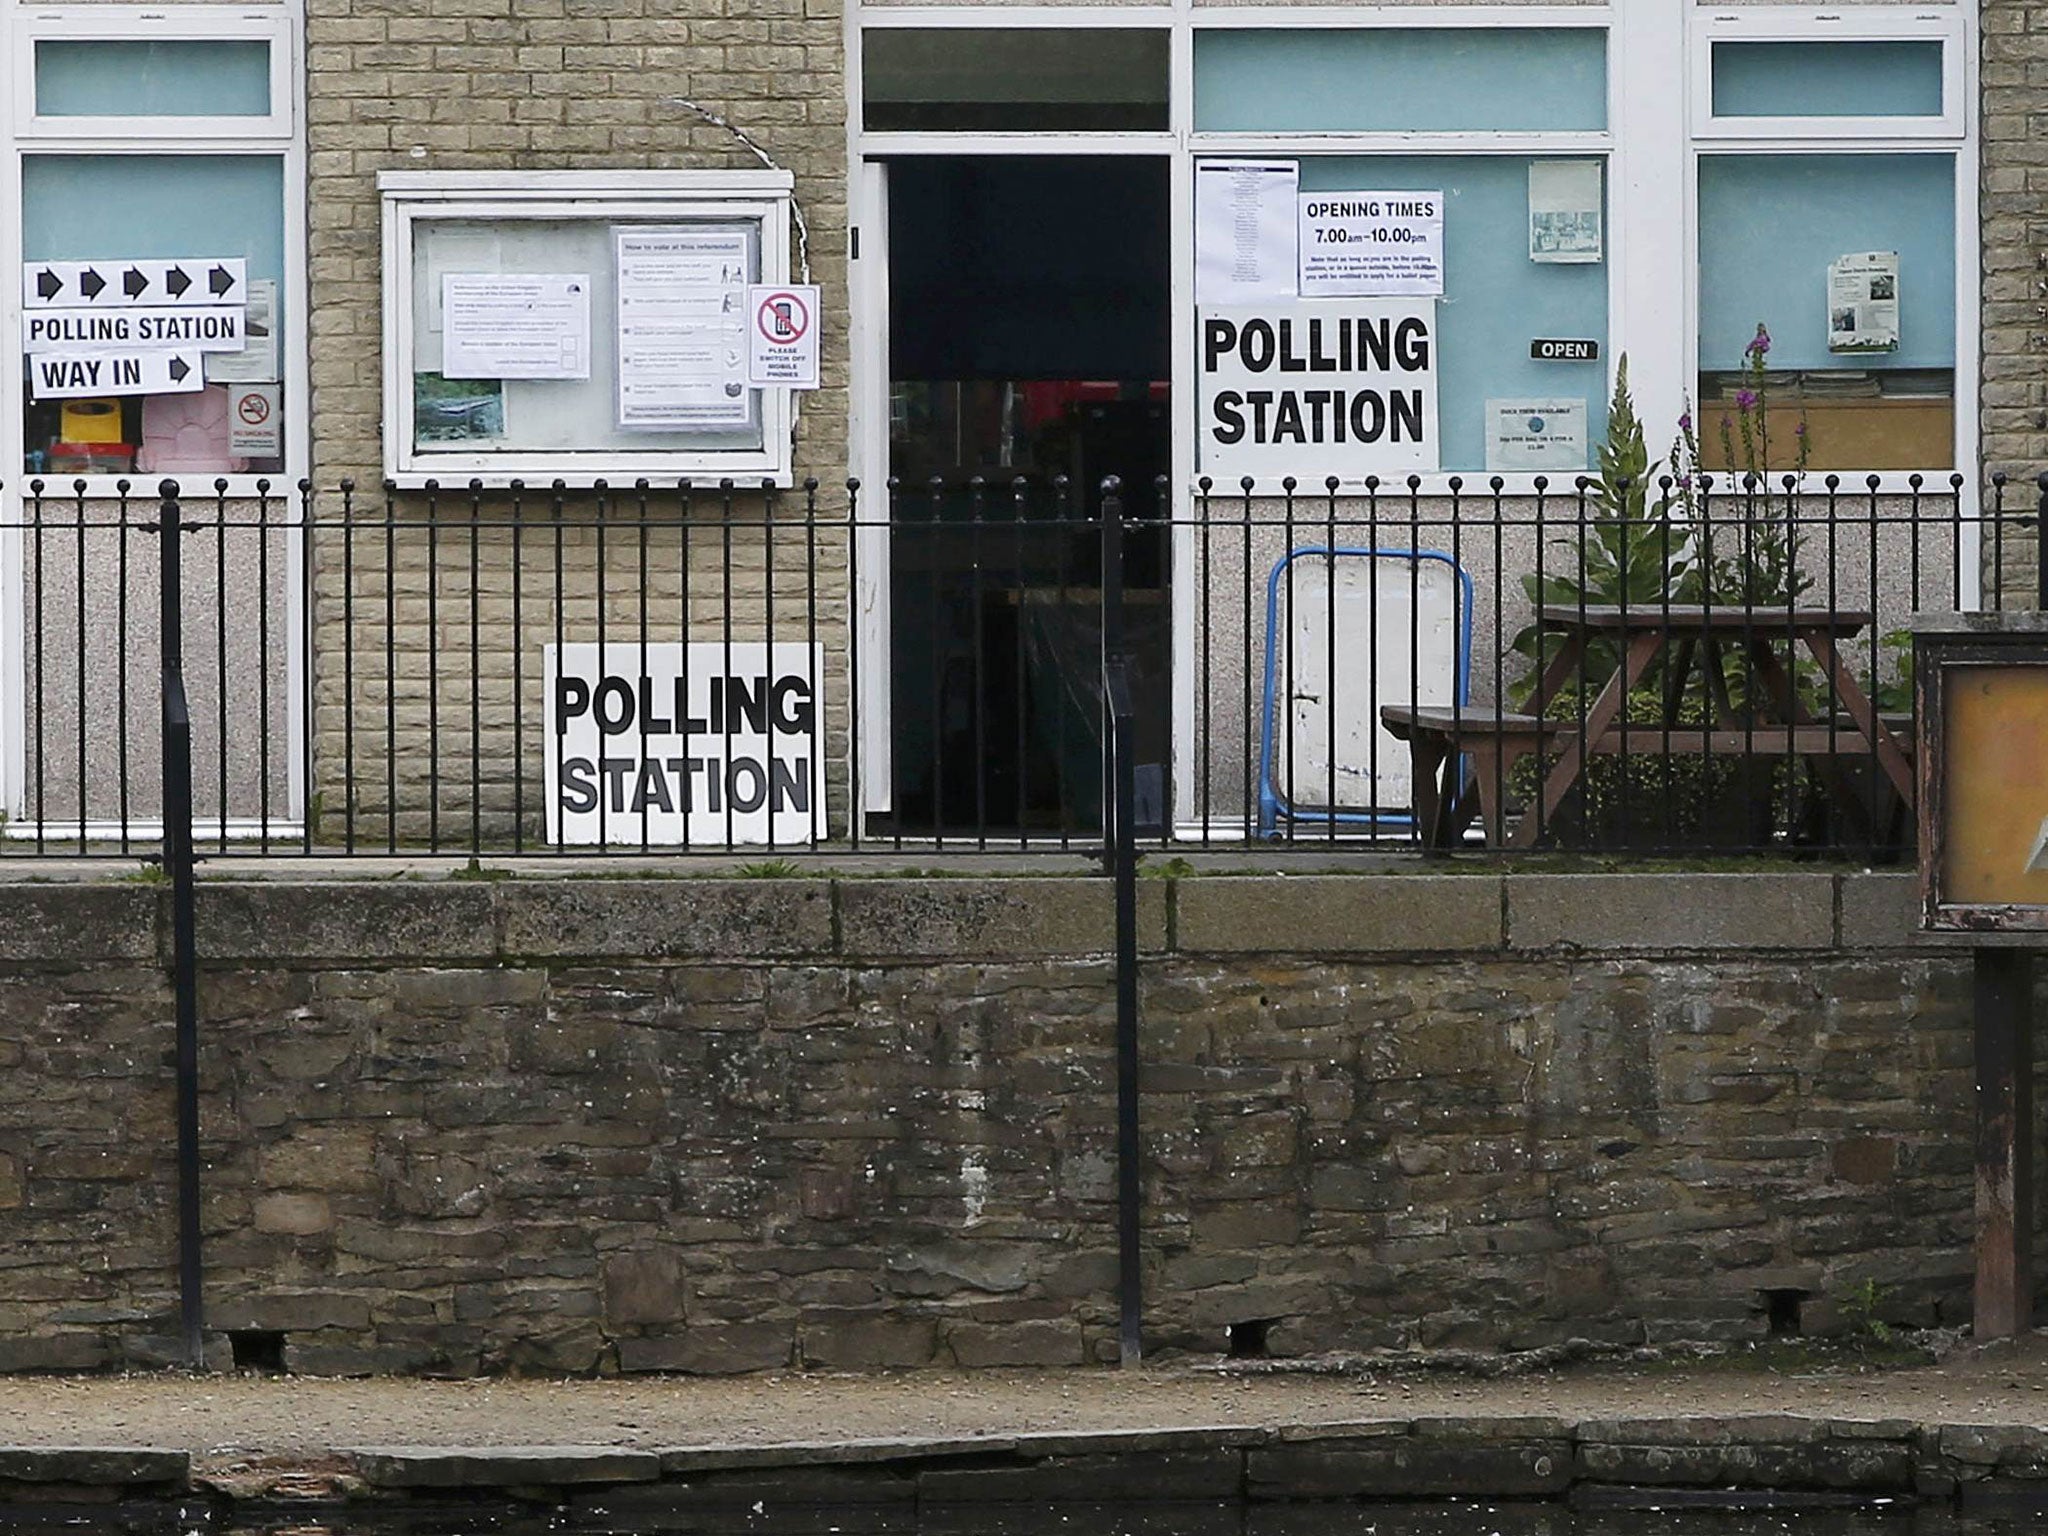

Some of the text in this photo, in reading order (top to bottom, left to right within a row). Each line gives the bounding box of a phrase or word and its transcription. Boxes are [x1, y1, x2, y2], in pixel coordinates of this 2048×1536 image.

[1307, 202, 1434, 218] OPENING TIMES
[31, 316, 236, 341] POLLING STATION
[1205, 317, 1429, 373] POLLING
[1541, 342, 1588, 357] OPEN
[42, 358, 142, 389] WAY IN
[1212, 389, 1423, 444] STATION
[556, 675, 815, 736] POLLING
[561, 757, 809, 814] STATION
